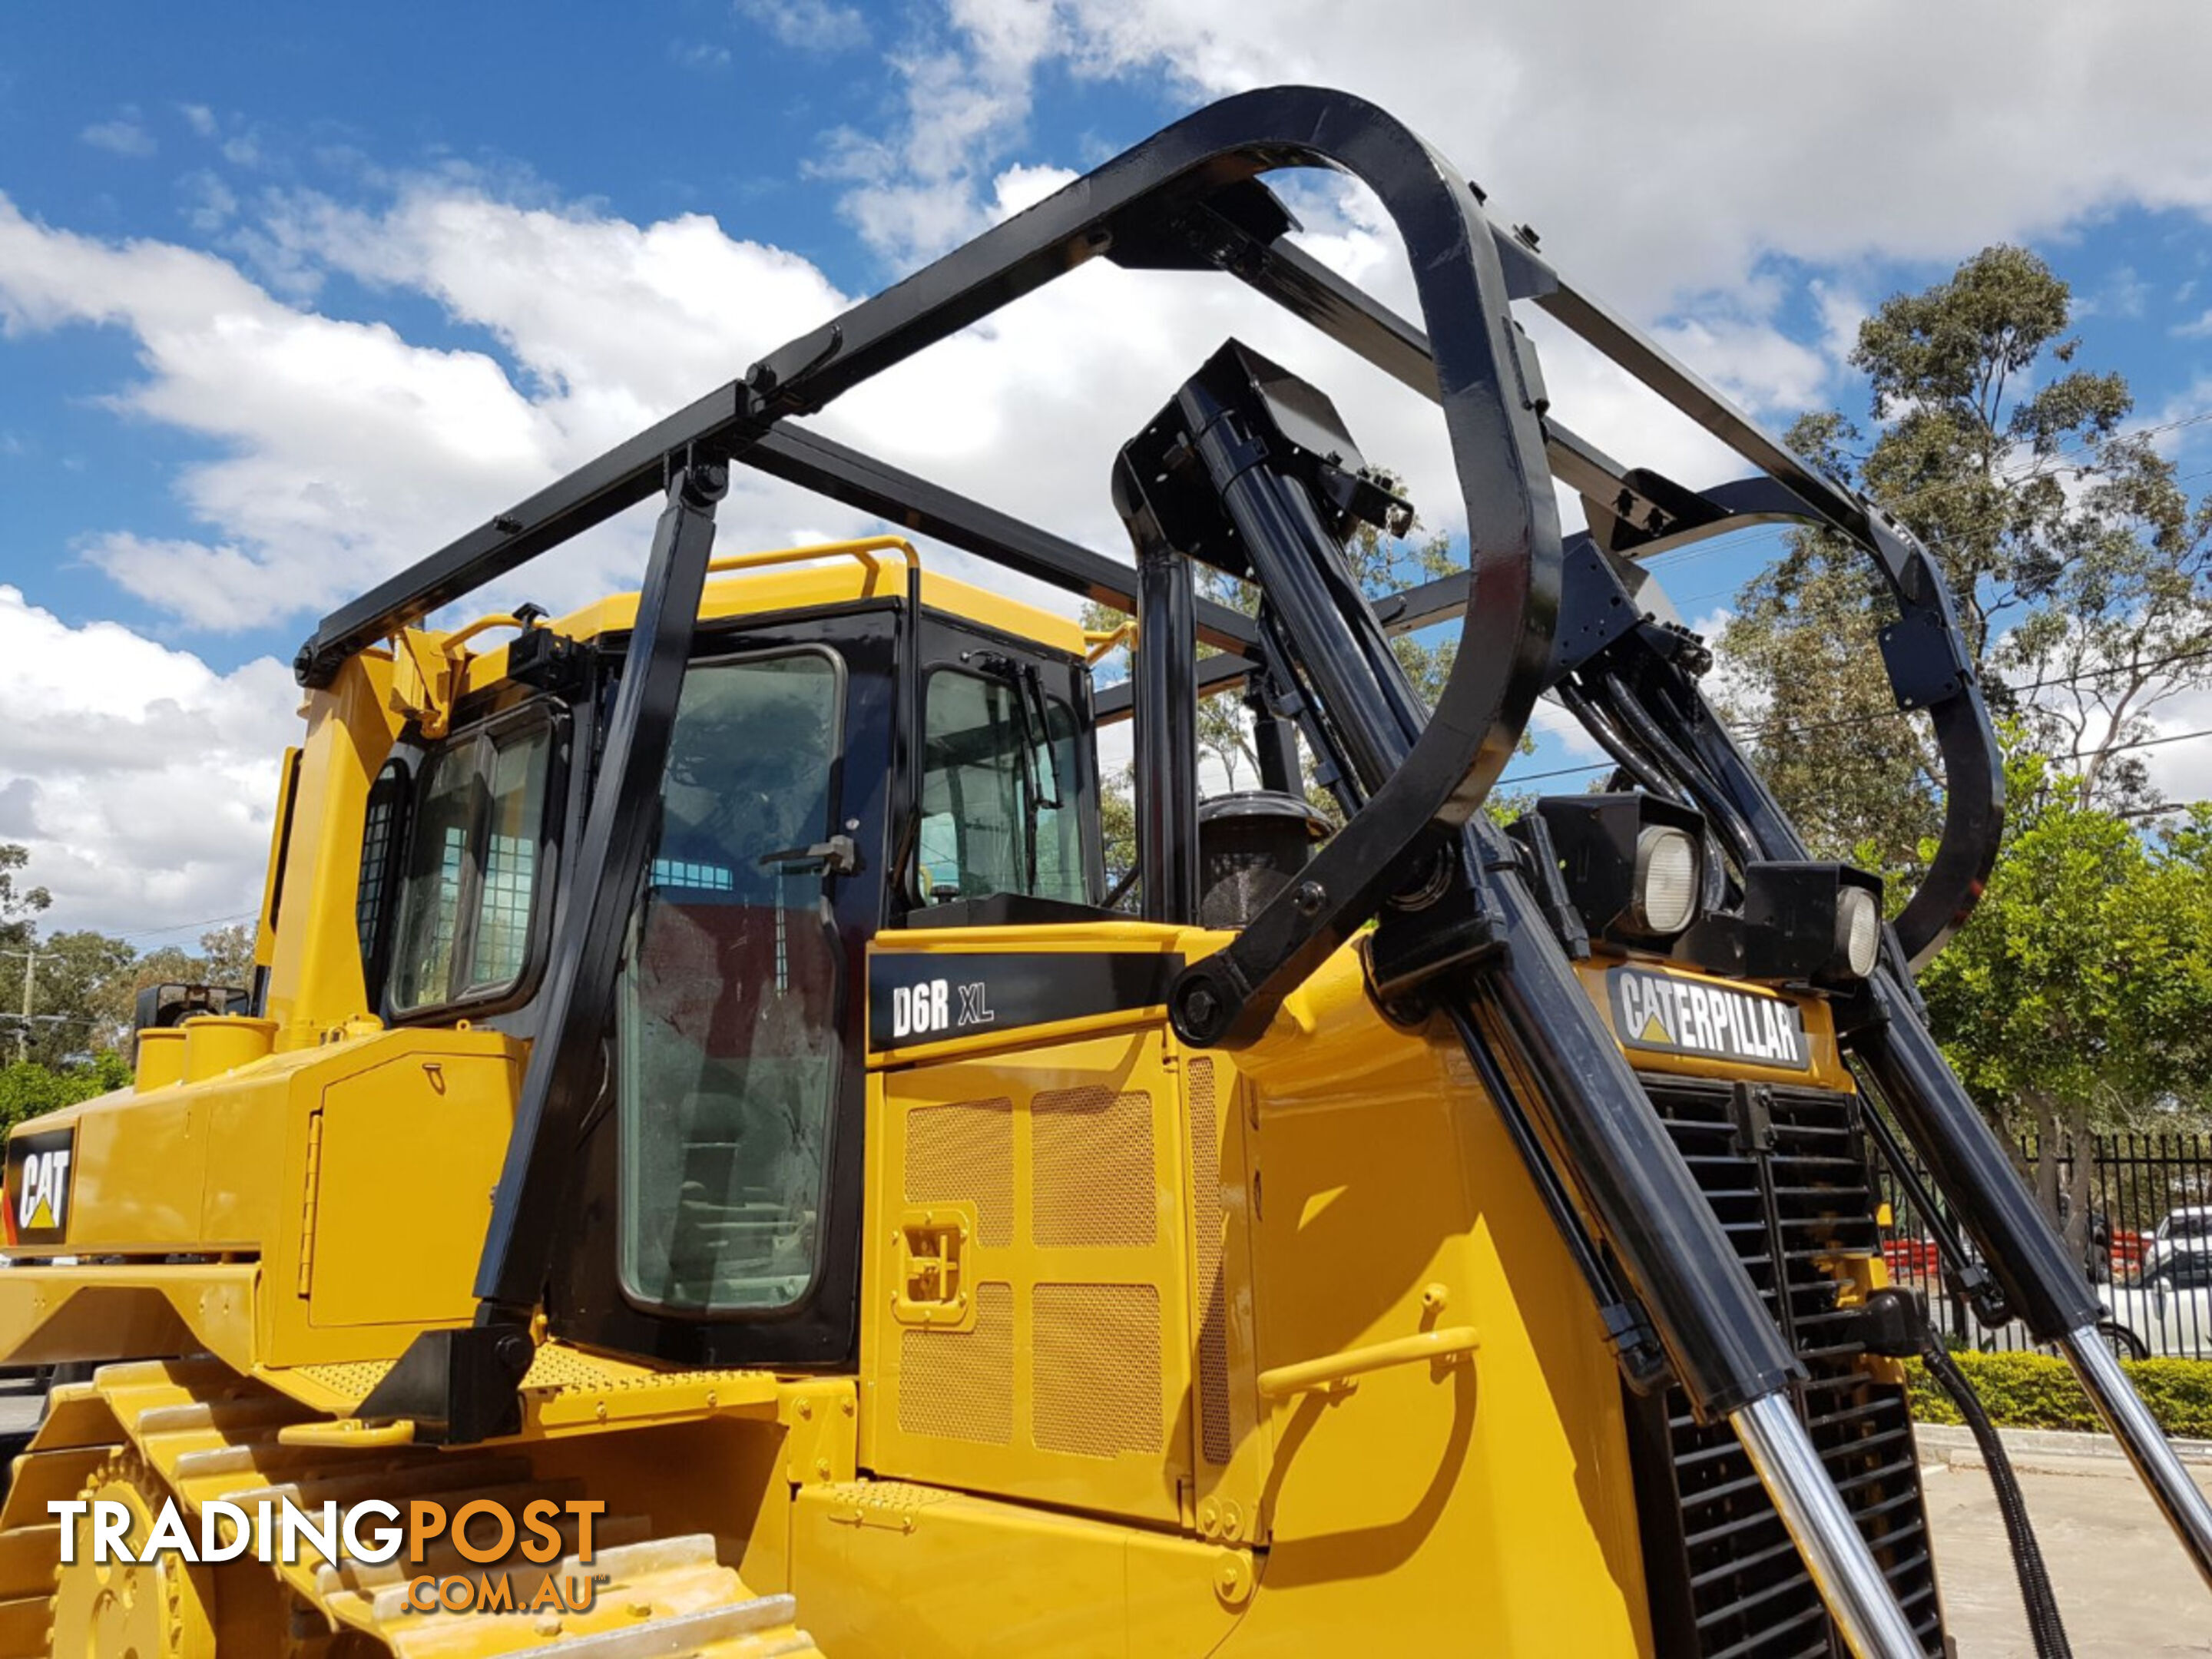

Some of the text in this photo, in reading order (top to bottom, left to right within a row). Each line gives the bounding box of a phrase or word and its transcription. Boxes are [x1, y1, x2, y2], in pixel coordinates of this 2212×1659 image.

[893, 979, 995, 1038] D6R XL
[1620, 972, 1799, 1061] CATERPILLAR
[19, 1150, 70, 1229] CAT
